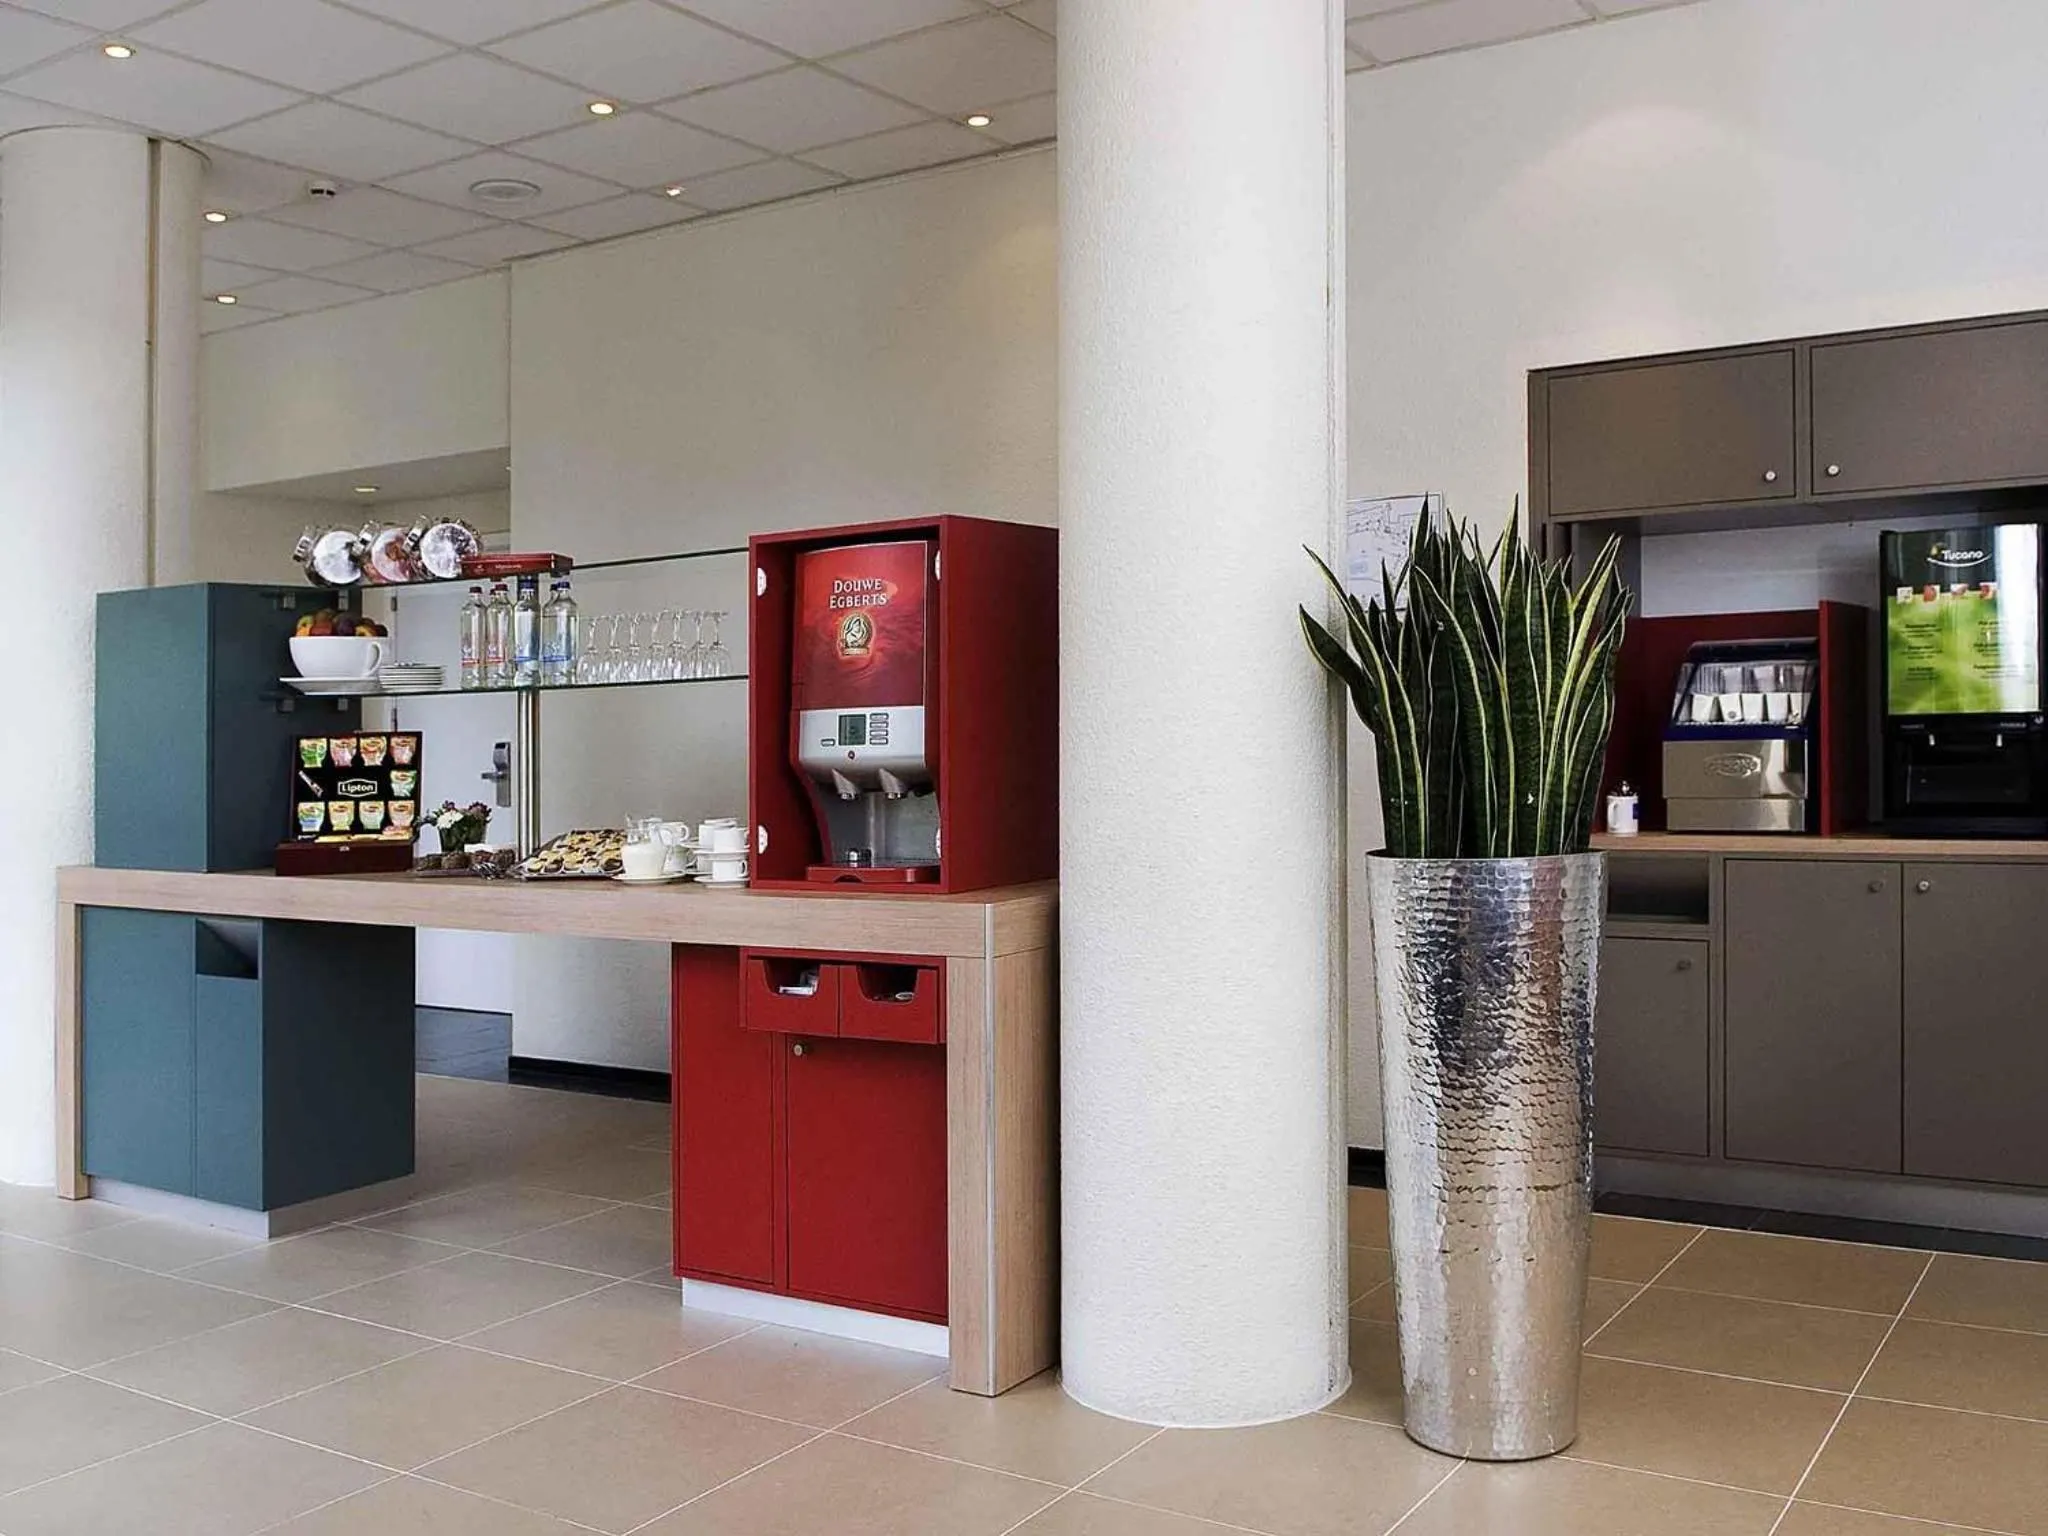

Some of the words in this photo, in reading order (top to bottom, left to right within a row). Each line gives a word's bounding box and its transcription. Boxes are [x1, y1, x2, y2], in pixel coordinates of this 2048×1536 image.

[834, 579, 882, 593] DOUWE
[830, 594, 887, 609] EGBERTS
[342, 784, 374, 793] Lipton
